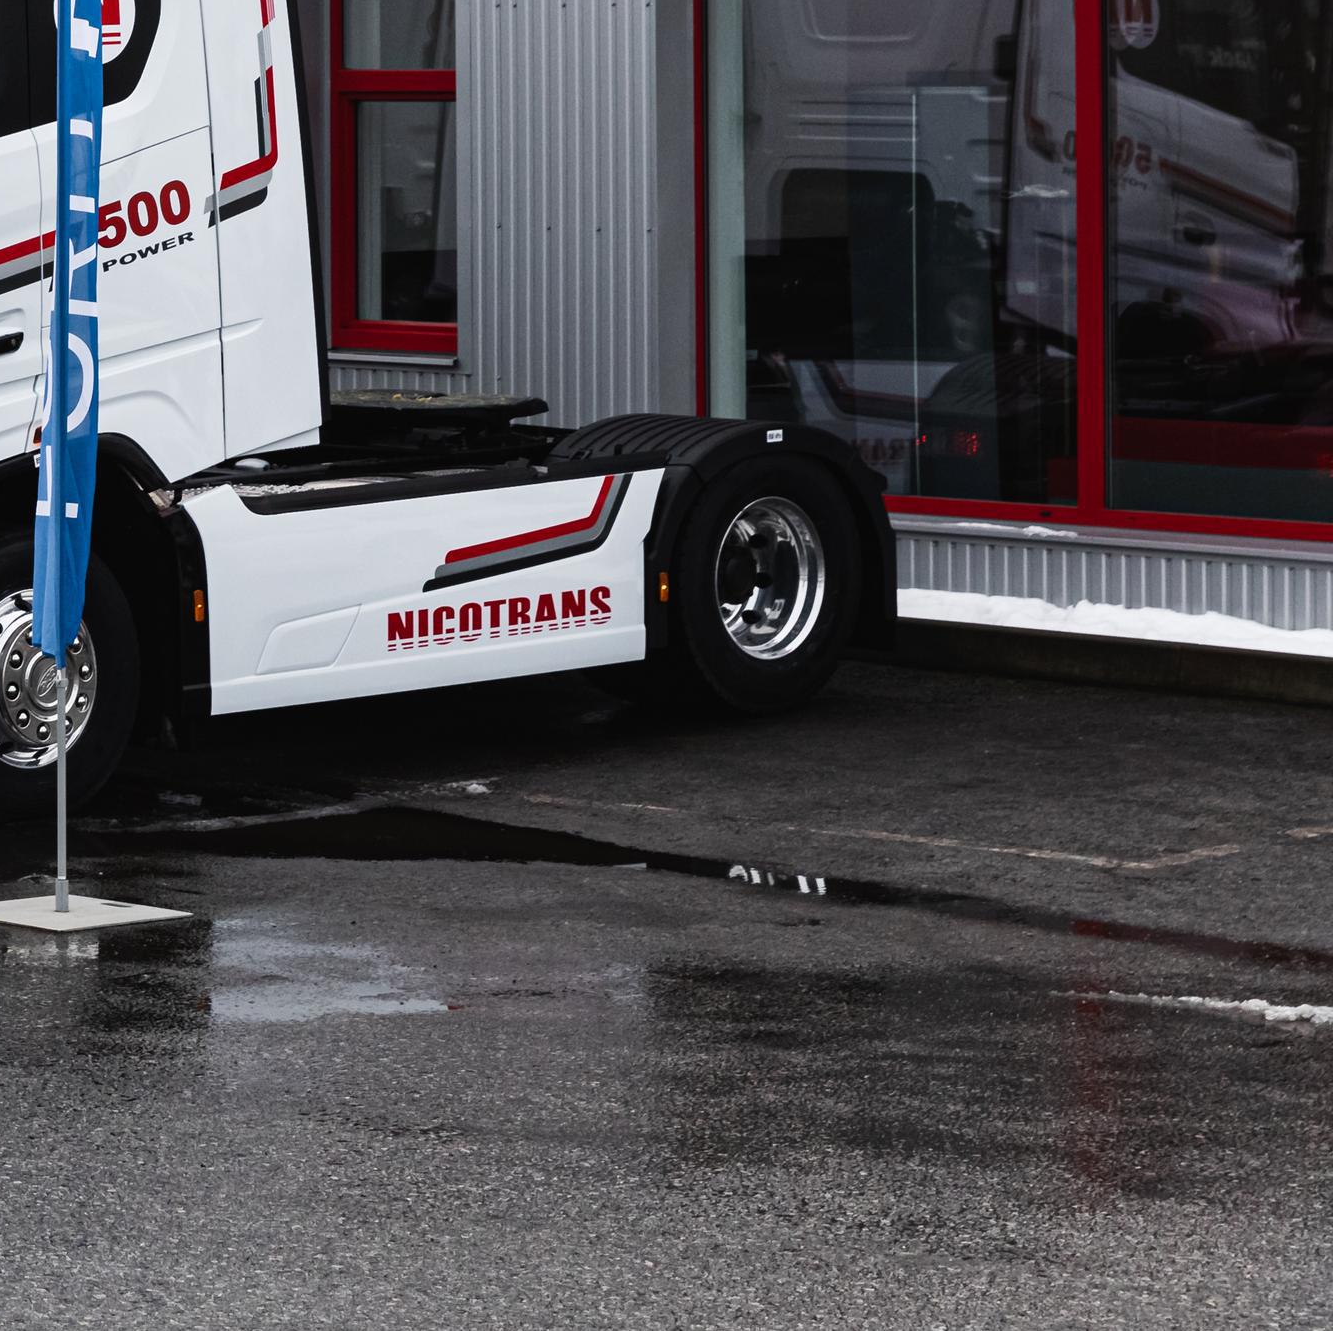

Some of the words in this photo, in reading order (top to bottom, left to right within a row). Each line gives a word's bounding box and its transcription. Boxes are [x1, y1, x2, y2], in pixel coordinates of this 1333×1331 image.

[98, 179, 191, 249] 500
[102, 231, 195, 272] POWER
[387, 586, 612, 651] NICOTRANS
